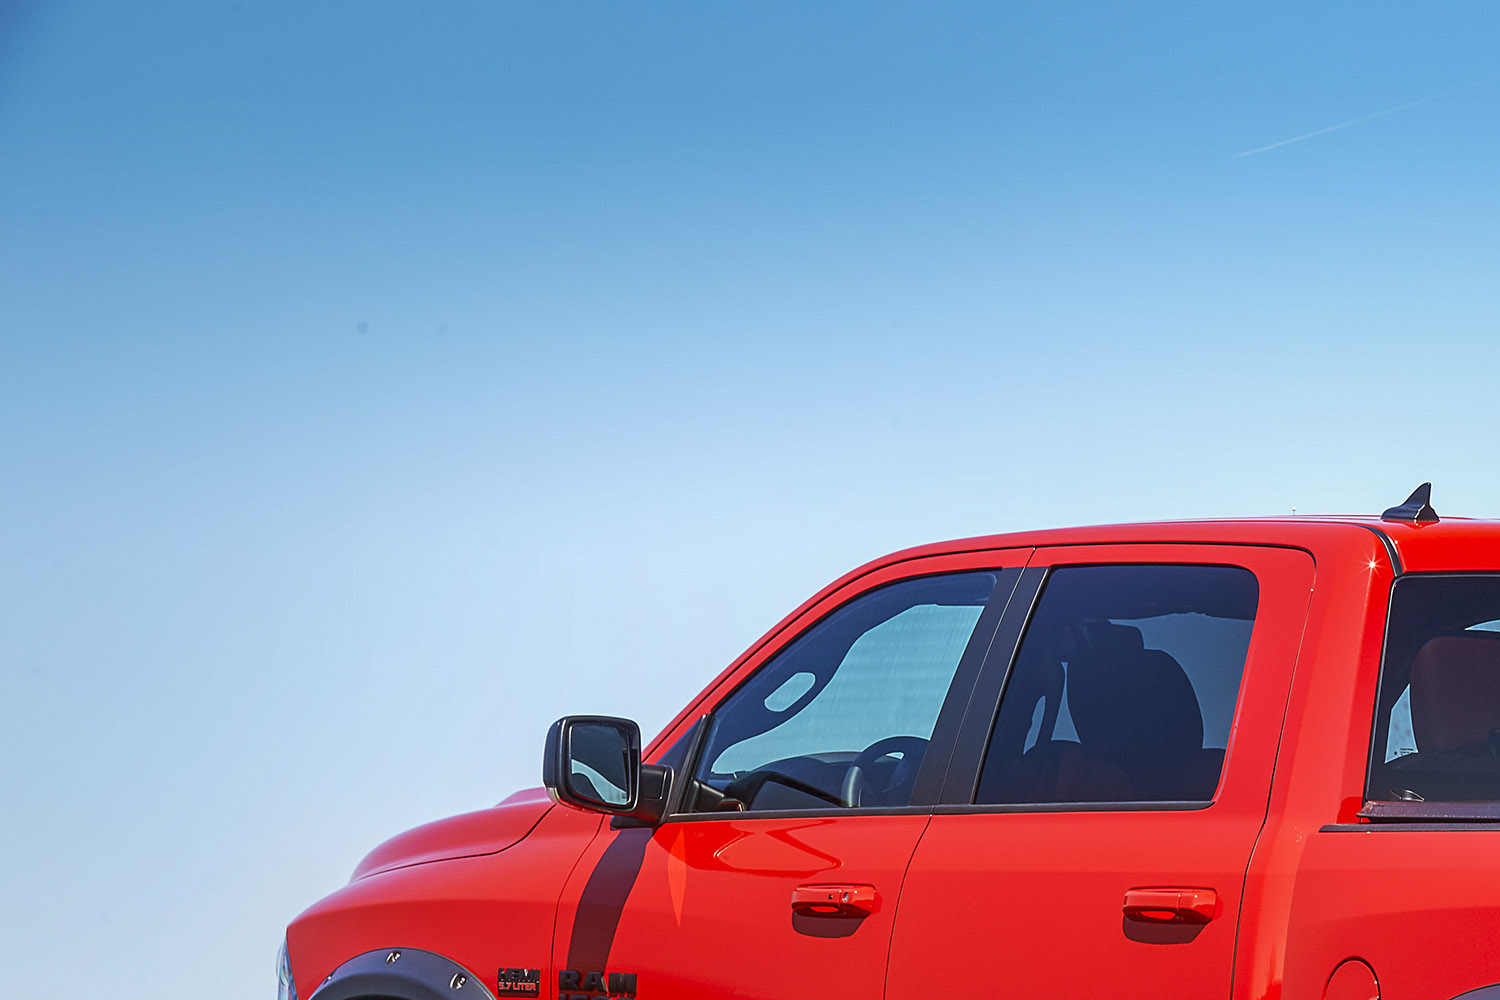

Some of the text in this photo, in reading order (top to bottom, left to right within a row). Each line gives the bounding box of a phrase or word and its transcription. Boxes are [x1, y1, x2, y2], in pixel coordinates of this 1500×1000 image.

[498, 981, 537, 991] 5.7 LITER
[559, 970, 638, 997] RAM
